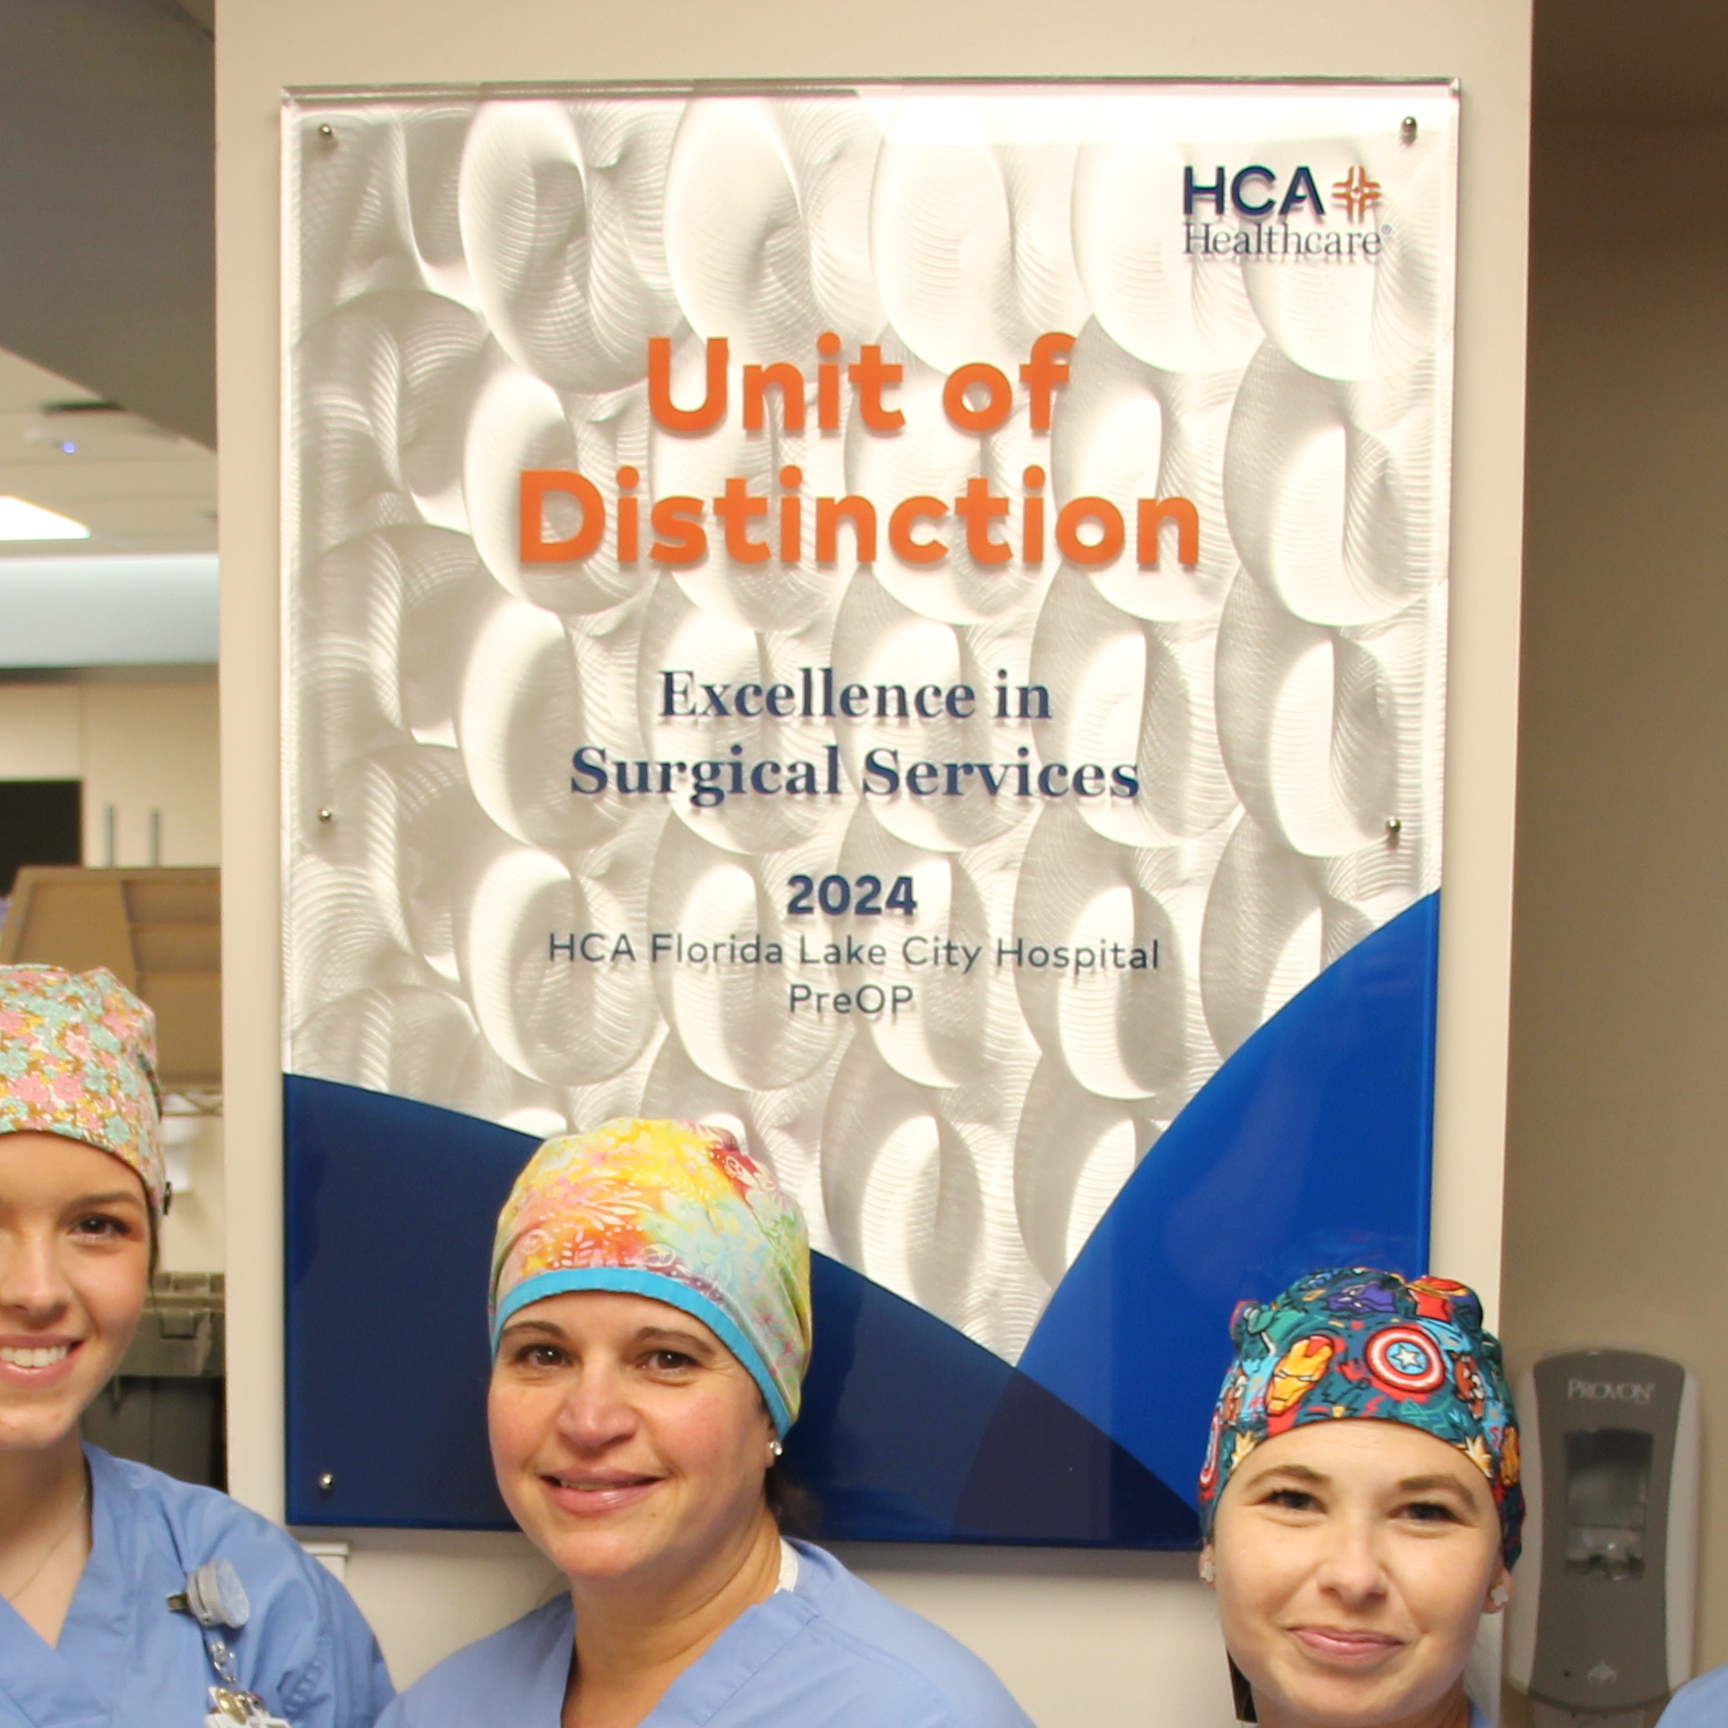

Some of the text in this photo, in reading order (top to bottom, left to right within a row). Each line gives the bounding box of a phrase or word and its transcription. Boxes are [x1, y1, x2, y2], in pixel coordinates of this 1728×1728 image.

[1183, 165, 1326, 216] HCA
[1183, 222, 1382, 255] Healthcare
[647, 331, 1077, 433] Unit of
[519, 464, 1199, 565] Distinction
[659, 667, 1052, 719] Excellence in
[571, 744, 1140, 807] Surgical Services
[786, 874, 918, 917] 2024
[548, 932, 1159, 974] HCA Florida Lake City Hospital
[788, 983, 915, 1015] PreOP
[1566, 1378, 1652, 1405] PROVON
